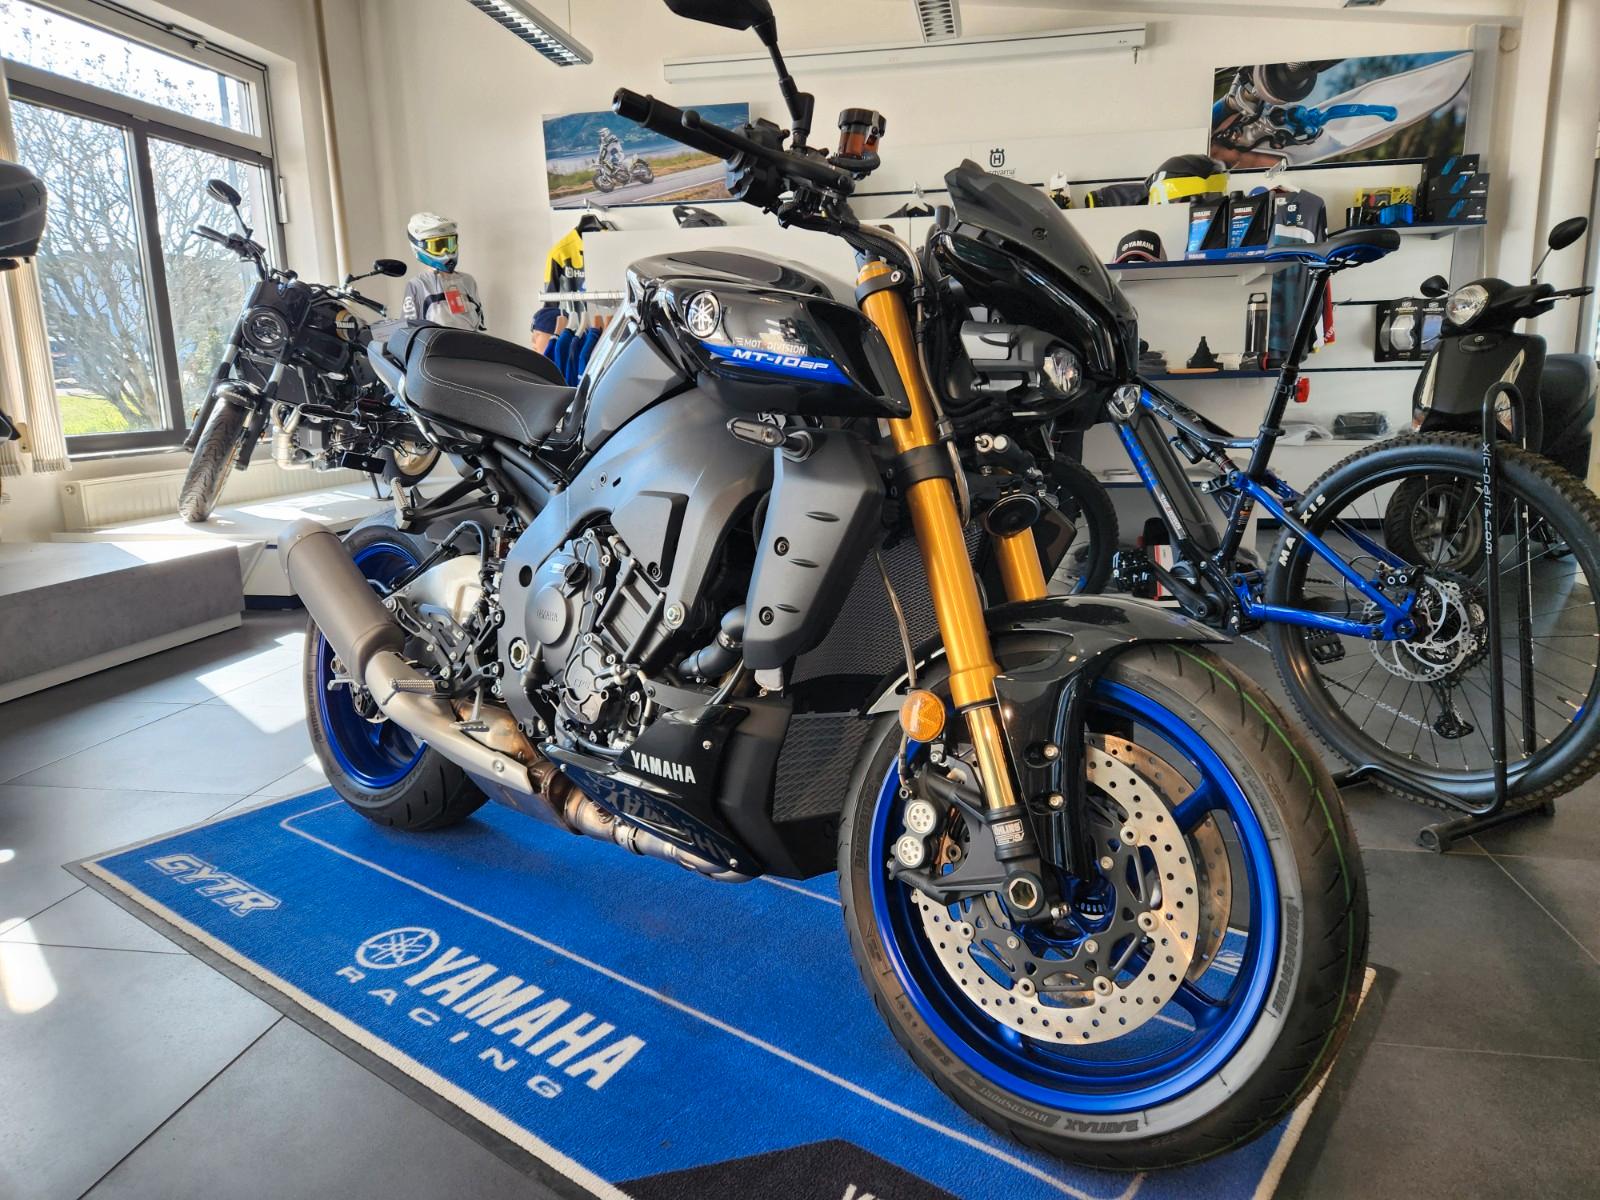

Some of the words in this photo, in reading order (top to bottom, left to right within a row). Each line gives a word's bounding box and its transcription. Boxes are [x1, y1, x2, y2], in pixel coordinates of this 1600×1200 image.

[1128, 240, 1155, 251] YAMAHA
[732, 348, 829, 370] MT-10SP
[1278, 494, 1326, 567] MAXIS
[1482, 441, 1494, 555] xlc-parts.com
[630, 749, 697, 785] YAMAHA
[144, 853, 282, 918] GYTR
[1272, 902, 1300, 1016] BRIDGESTONE
[336, 966, 564, 1098] RACING
[404, 947, 646, 1090] YAMAHA
[980, 1087, 1049, 1123] HYPERSPORT
